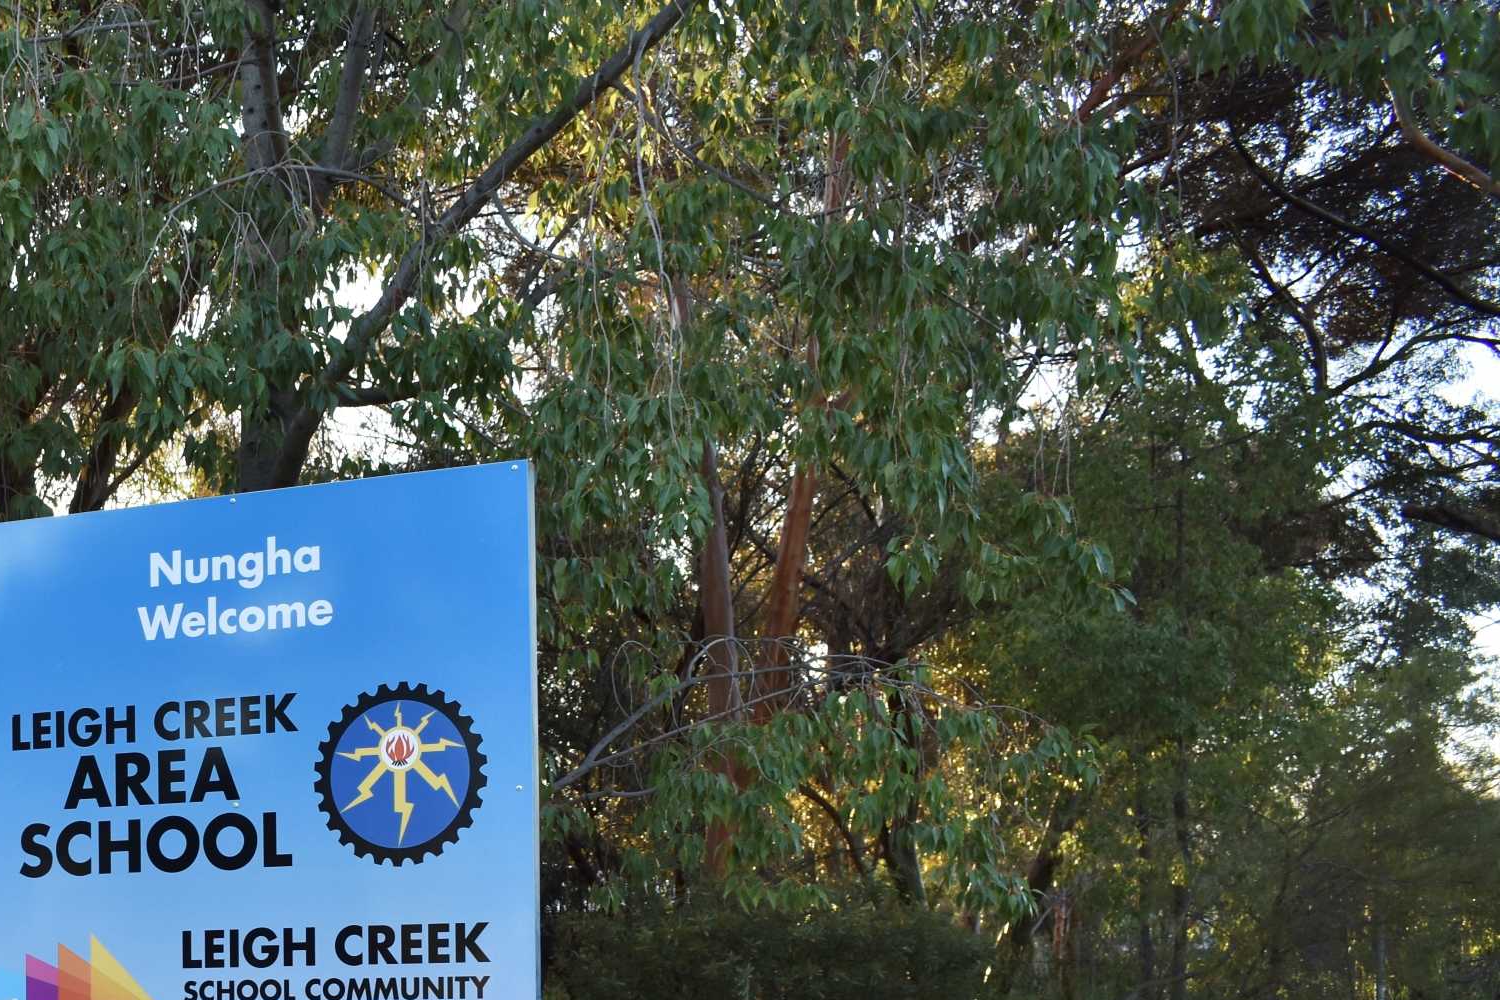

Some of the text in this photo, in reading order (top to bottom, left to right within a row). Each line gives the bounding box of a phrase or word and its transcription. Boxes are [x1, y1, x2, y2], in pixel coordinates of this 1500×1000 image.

[149, 536, 320, 589] Nungha
[138, 598, 333, 641] Welcome
[11, 693, 298, 751] LEIGH CREEK
[64, 746, 240, 810] AREA
[20, 812, 292, 878] SCHOOL
[182, 922, 491, 969] LEIGH CREEK
